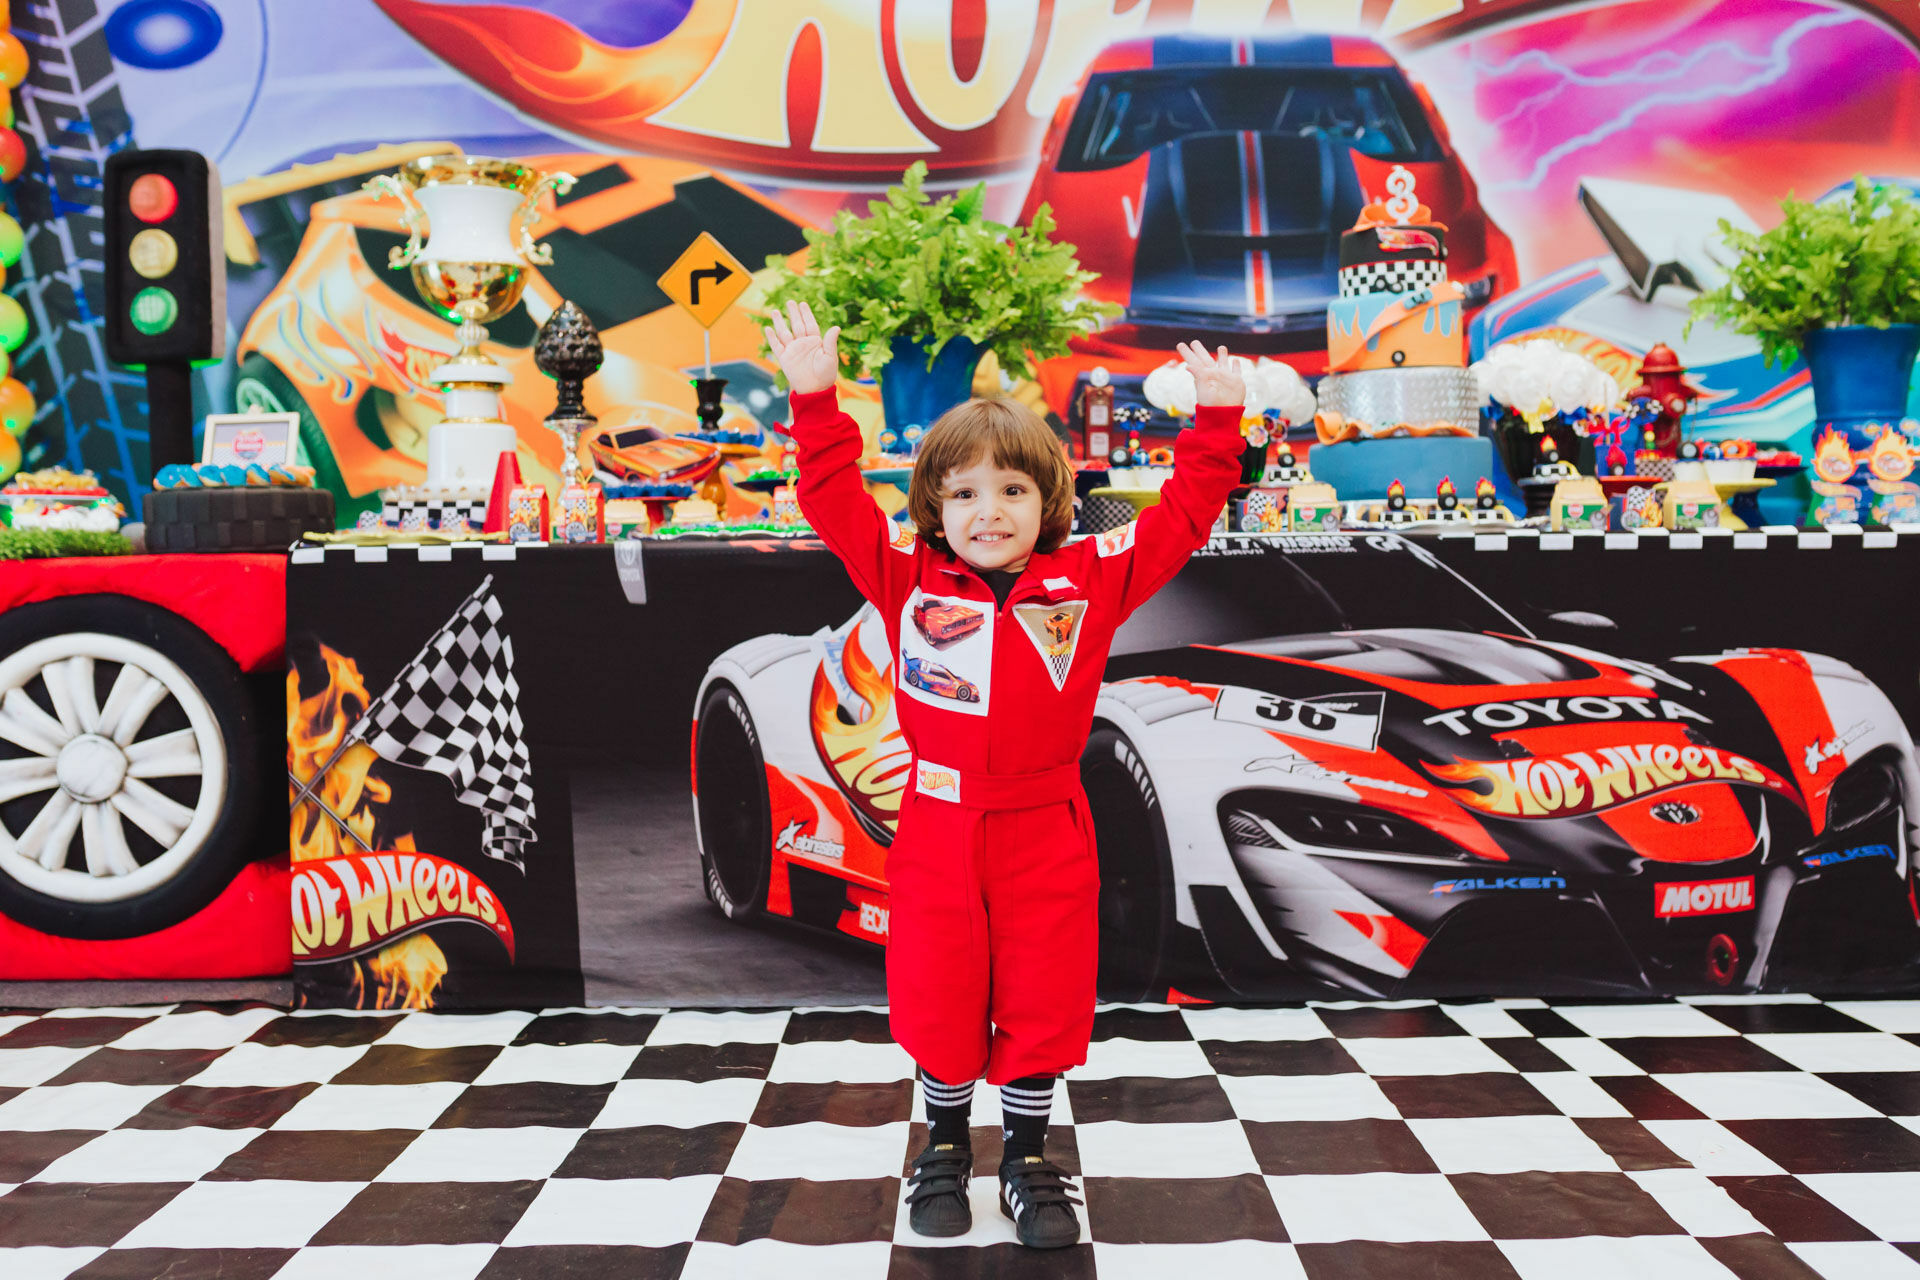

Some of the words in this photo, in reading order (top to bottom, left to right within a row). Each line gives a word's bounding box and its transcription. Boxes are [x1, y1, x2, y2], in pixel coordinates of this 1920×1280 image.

[1385, 165, 1420, 222] 3
[1423, 697, 1714, 736] TOYOTA
[1661, 881, 1753, 912] MOTUL
